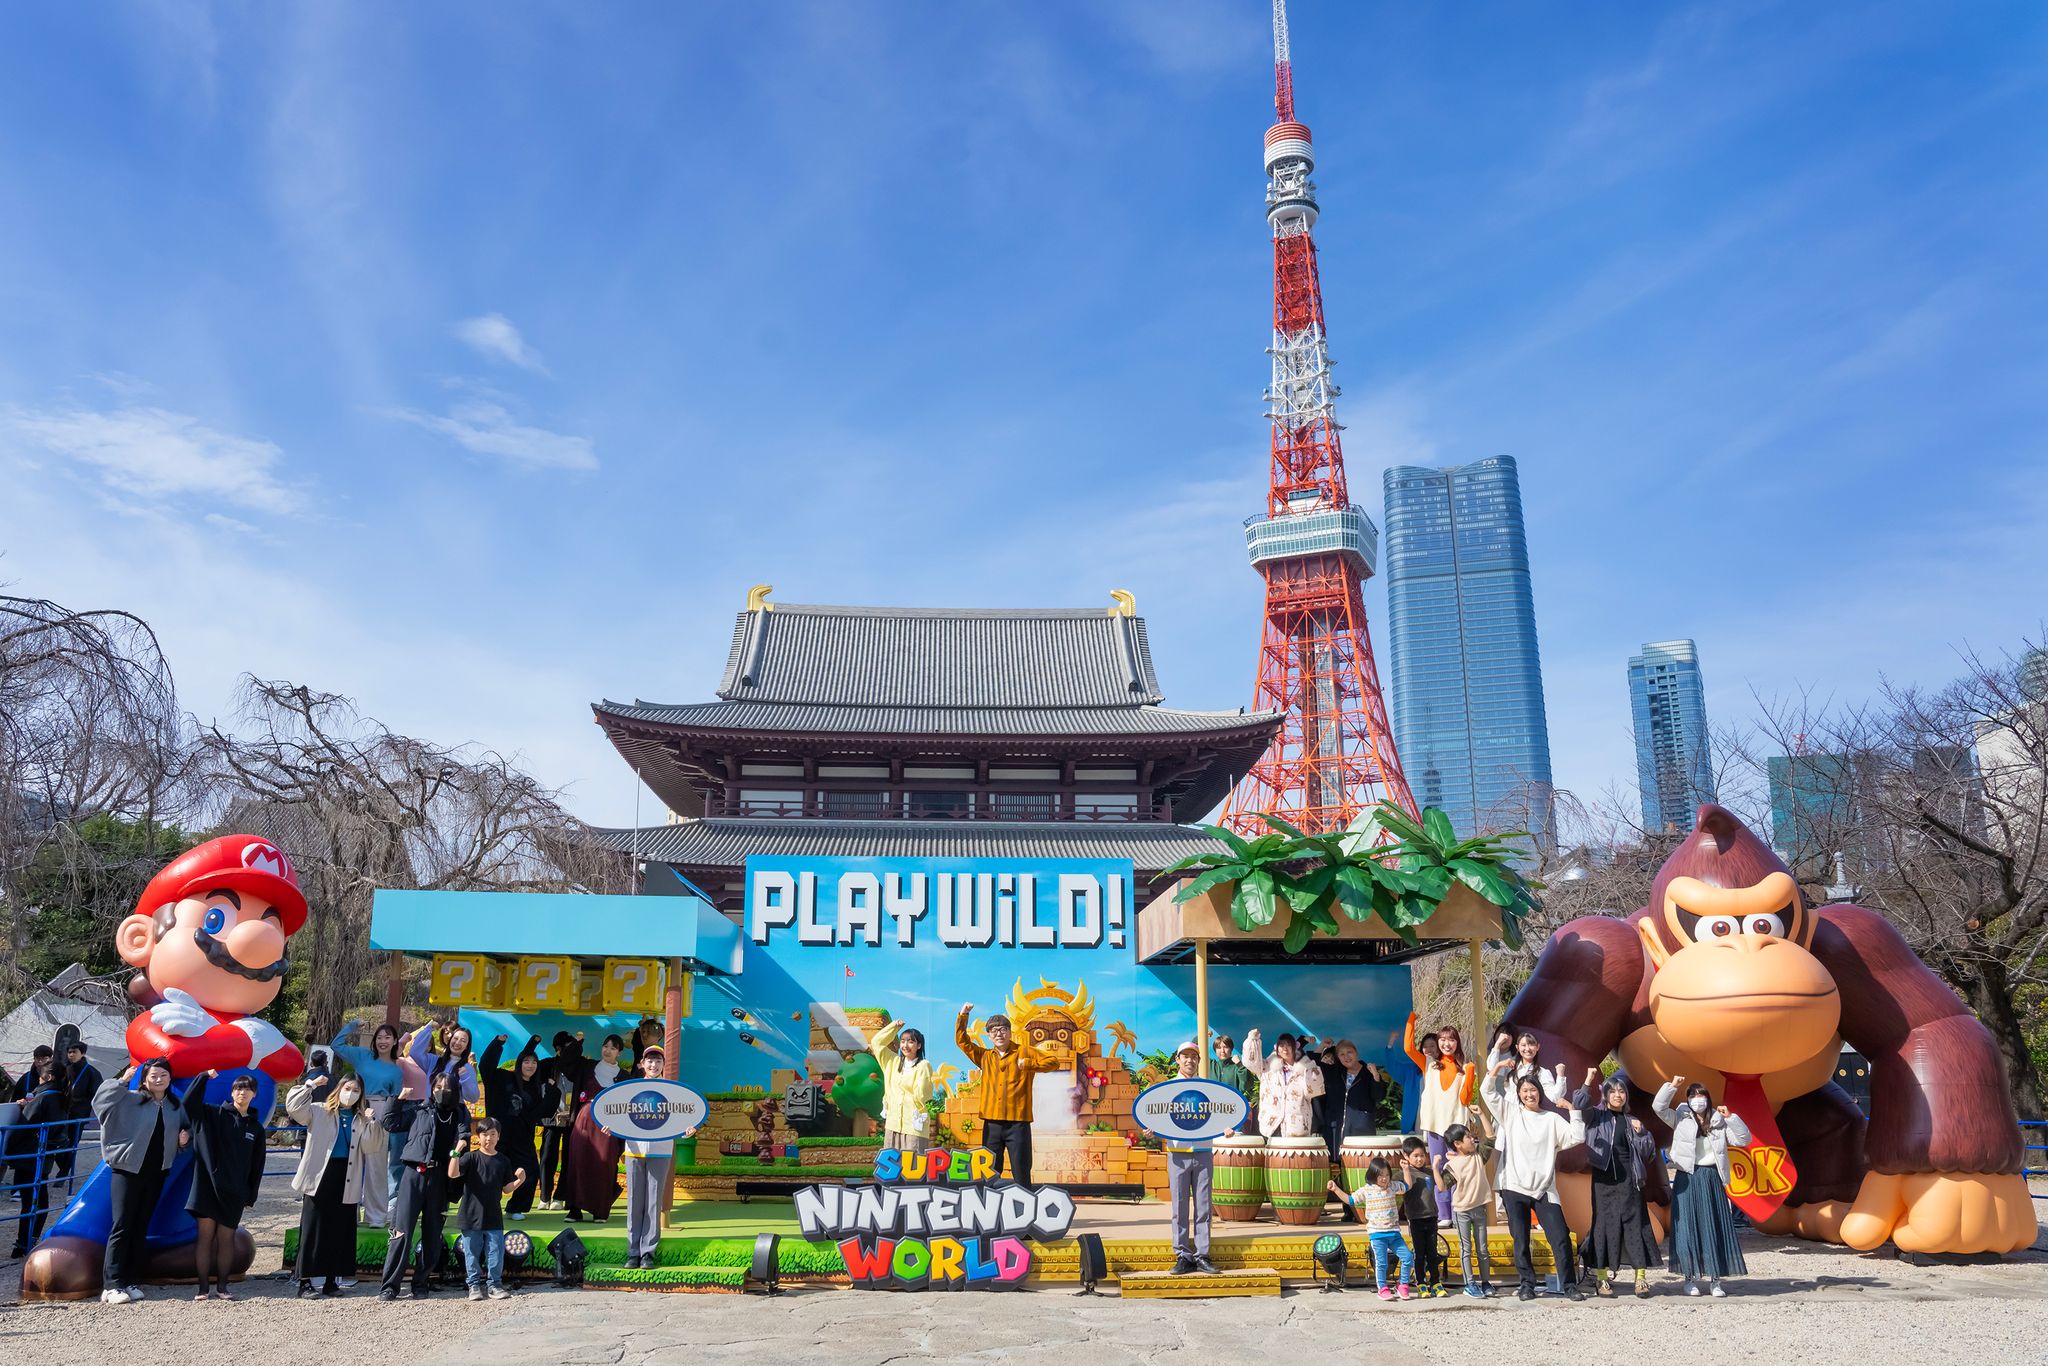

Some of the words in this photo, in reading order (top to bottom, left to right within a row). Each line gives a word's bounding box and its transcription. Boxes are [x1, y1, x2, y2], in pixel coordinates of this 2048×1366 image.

[244, 844, 286, 879] M
[752, 871, 928, 946] PLAY
[604, 1102, 654, 1115] UNIVERSAL
[657, 1102, 695, 1114] STUDIOS
[1147, 1102, 1196, 1114] UNIVERSAL
[1198, 1102, 1236, 1114] STUDIOS
[873, 1147, 999, 1182] SUPER
[1725, 1146, 1792, 1197] DK
[794, 1184, 1076, 1236] NINTENDO
[838, 1235, 1032, 1284] WORLD
